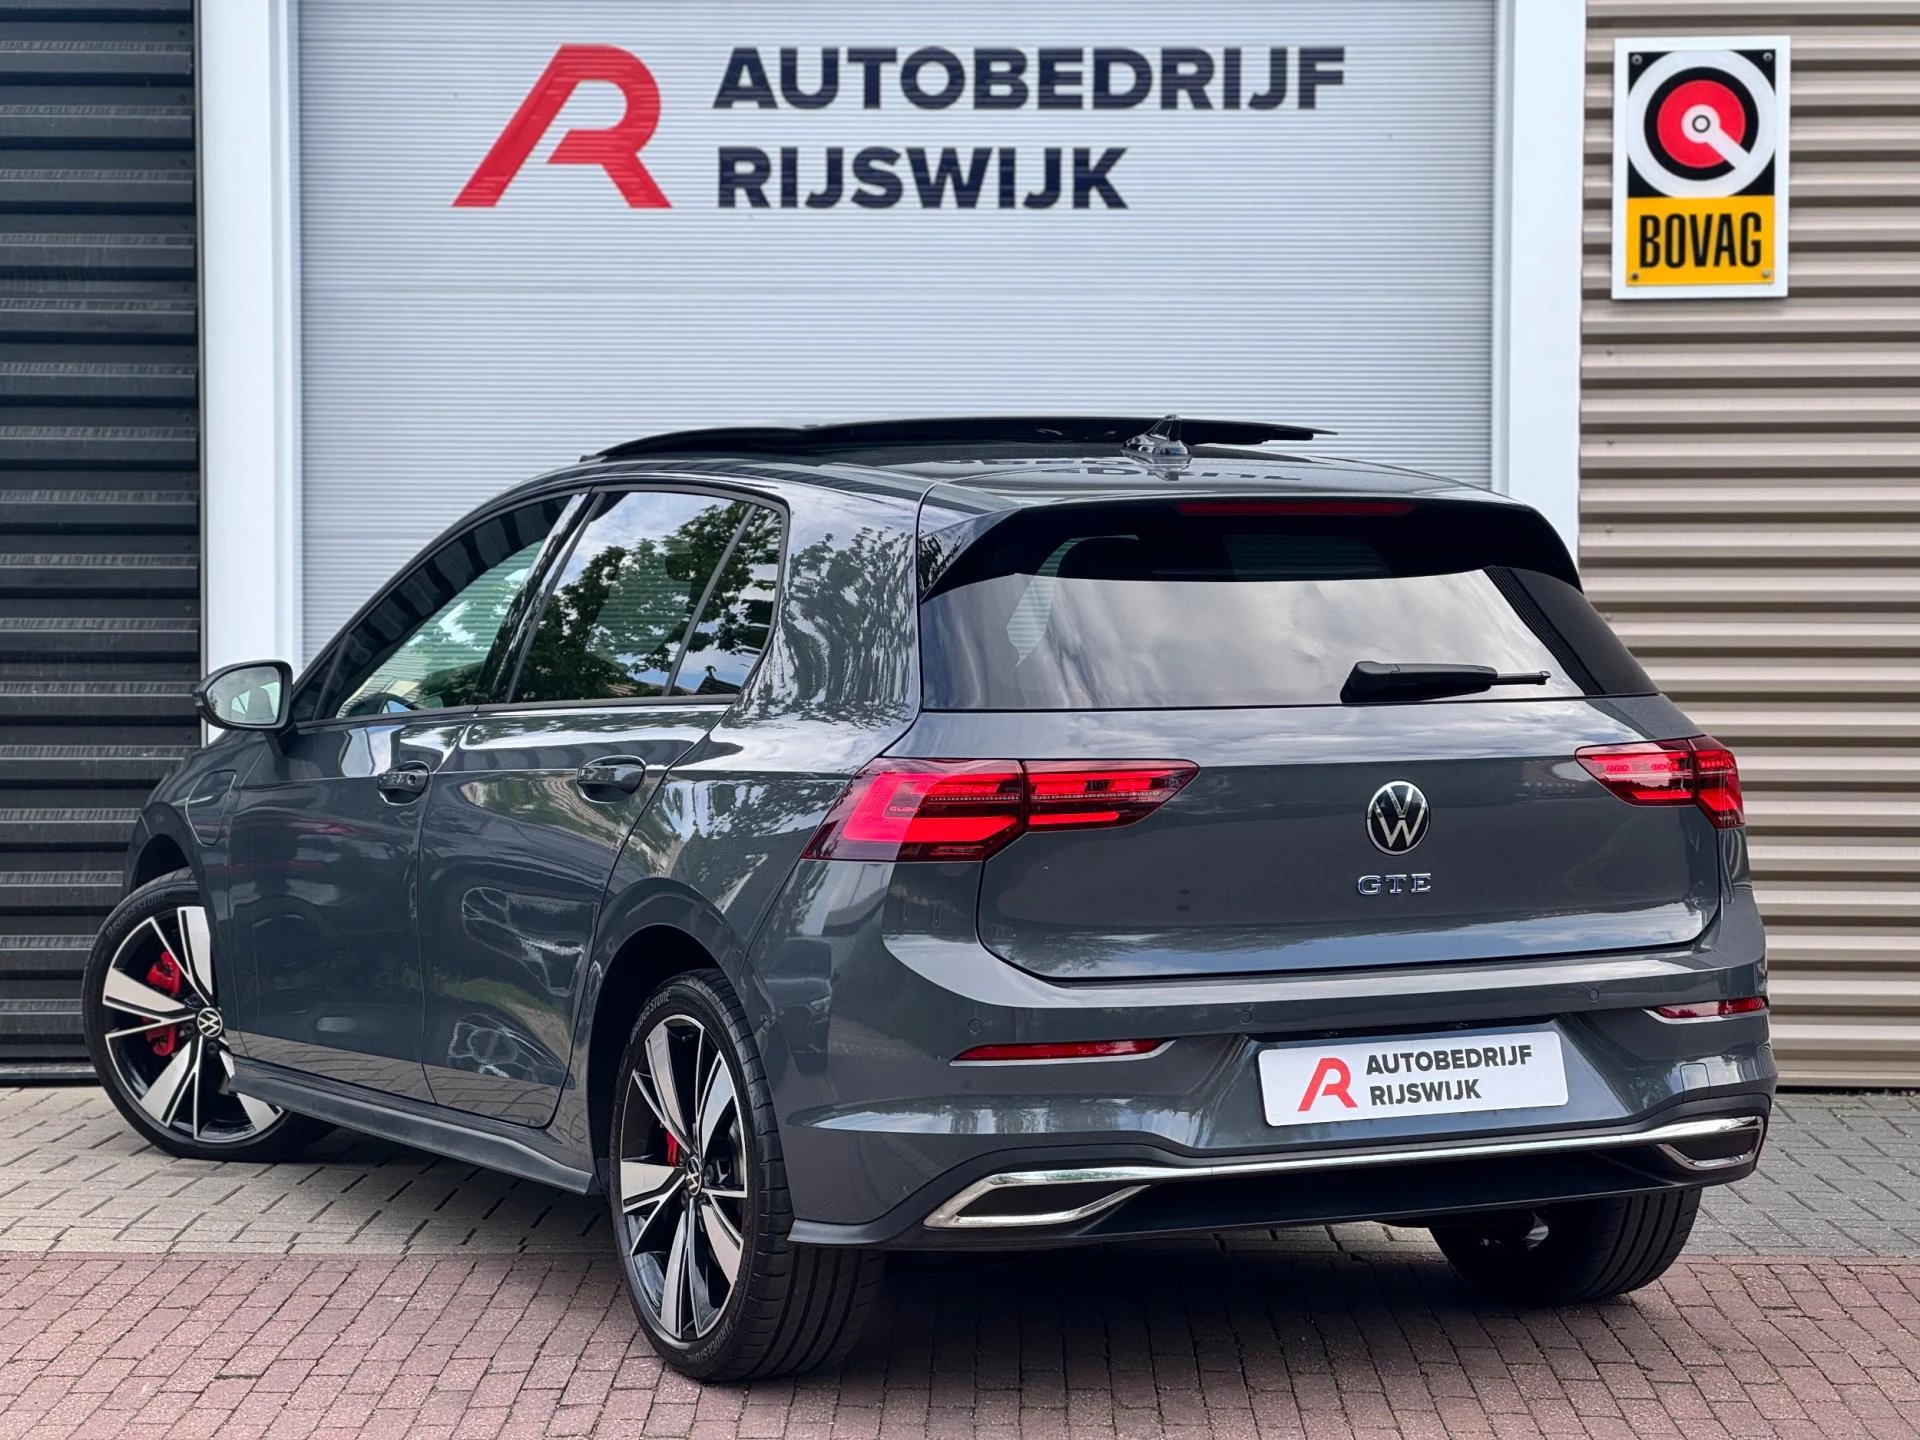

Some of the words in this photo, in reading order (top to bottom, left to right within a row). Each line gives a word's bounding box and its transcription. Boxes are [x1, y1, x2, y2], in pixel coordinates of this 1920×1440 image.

[712, 46, 1346, 111] AUTOBEDRIJF
[717, 146, 1130, 209] RIJSWIJK
[1639, 212, 1762, 268] BOVAG
[1357, 873, 1432, 895] GTE
[1366, 1044, 1533, 1076] AUTOBEDRIJF
[1369, 1078, 1483, 1106] RIJSWIJK
